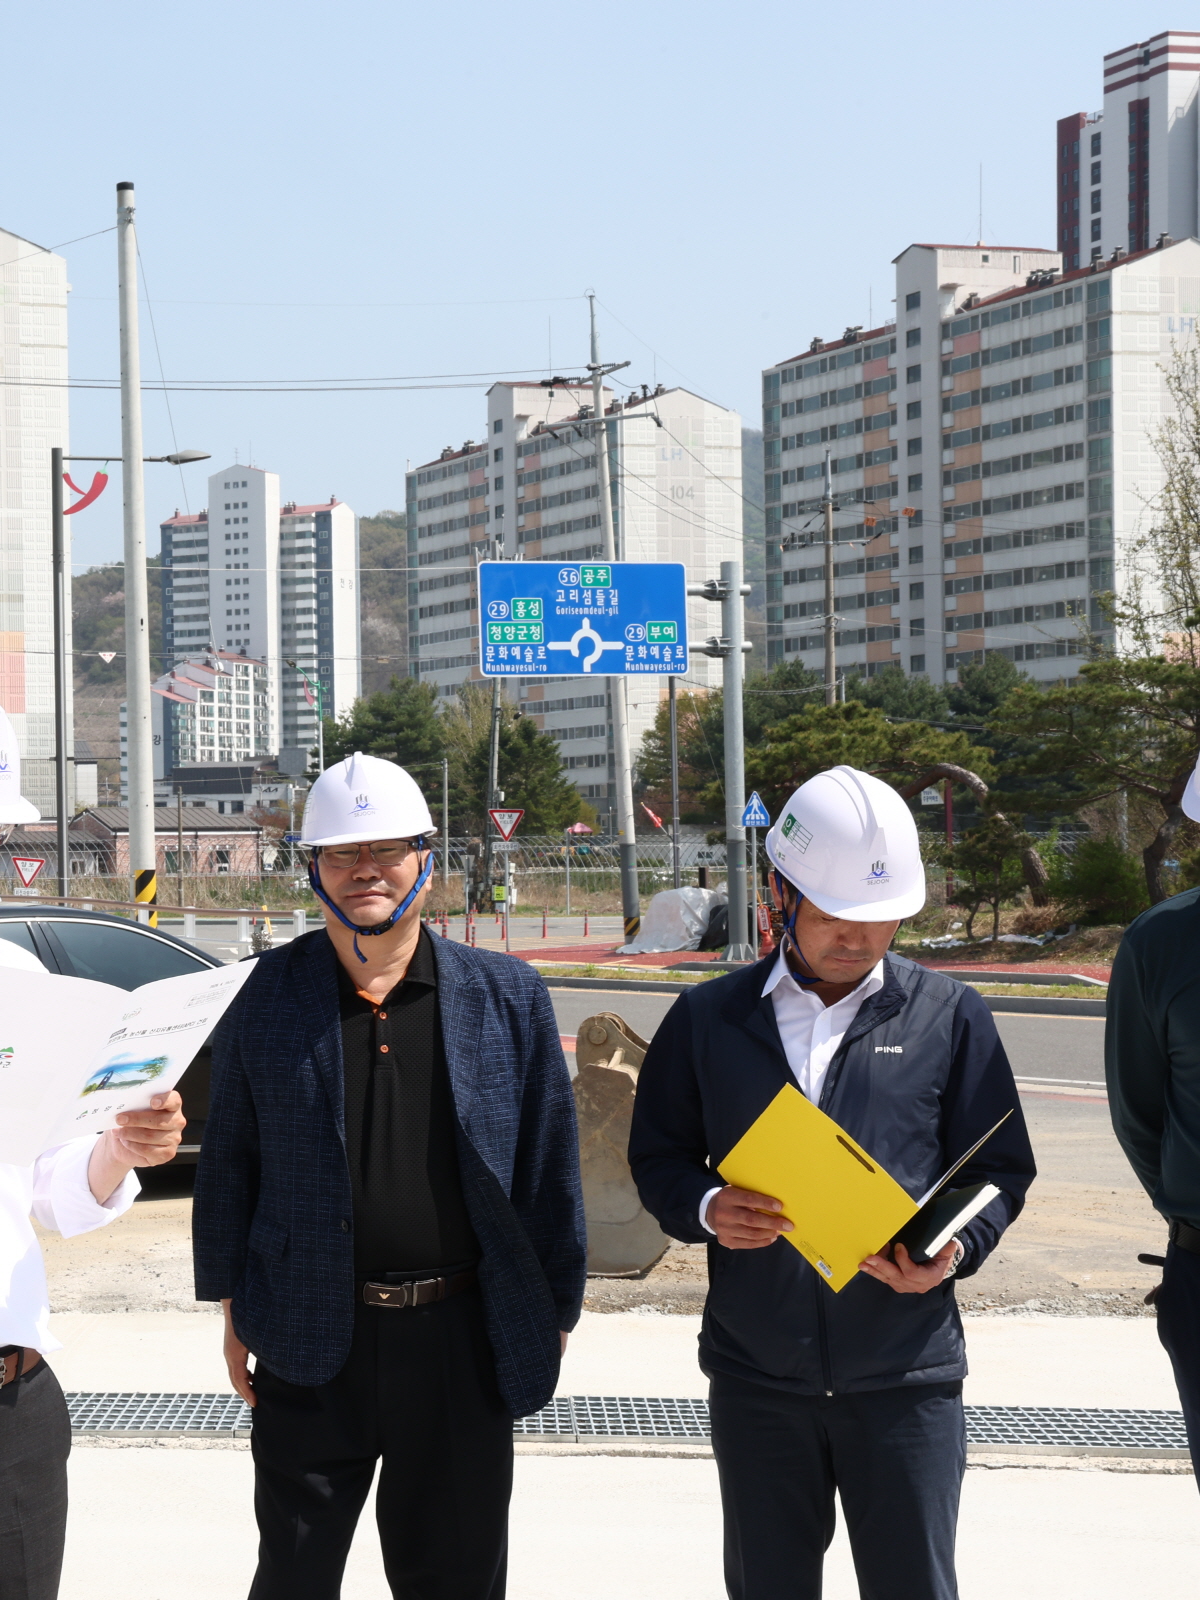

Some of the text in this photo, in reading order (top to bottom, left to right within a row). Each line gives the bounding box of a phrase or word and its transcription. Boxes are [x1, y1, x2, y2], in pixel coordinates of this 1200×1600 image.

[1168, 316, 1193, 333] LH
[661, 447, 683, 461] LH
[669, 485, 695, 500] 104
[561, 569, 608, 585] 36 공주
[555, 588, 620, 606] 고리섬들길
[490, 600, 541, 618] 29 홍성
[555, 605, 620, 617] Goriseomdeul-gil
[489, 625, 542, 642] 청양군청
[627, 624, 676, 640] 29 부여
[485, 645, 547, 663] 문화예술로
[625, 644, 686, 662] 문화예술로
[485, 663, 547, 673] Munhwayesul-ro
[625, 661, 686, 672] Munhwayesul-ro
[353, 810, 376, 818] SEJOON
[866, 878, 890, 886] SEJOON
[874, 1045, 904, 1054] PING
